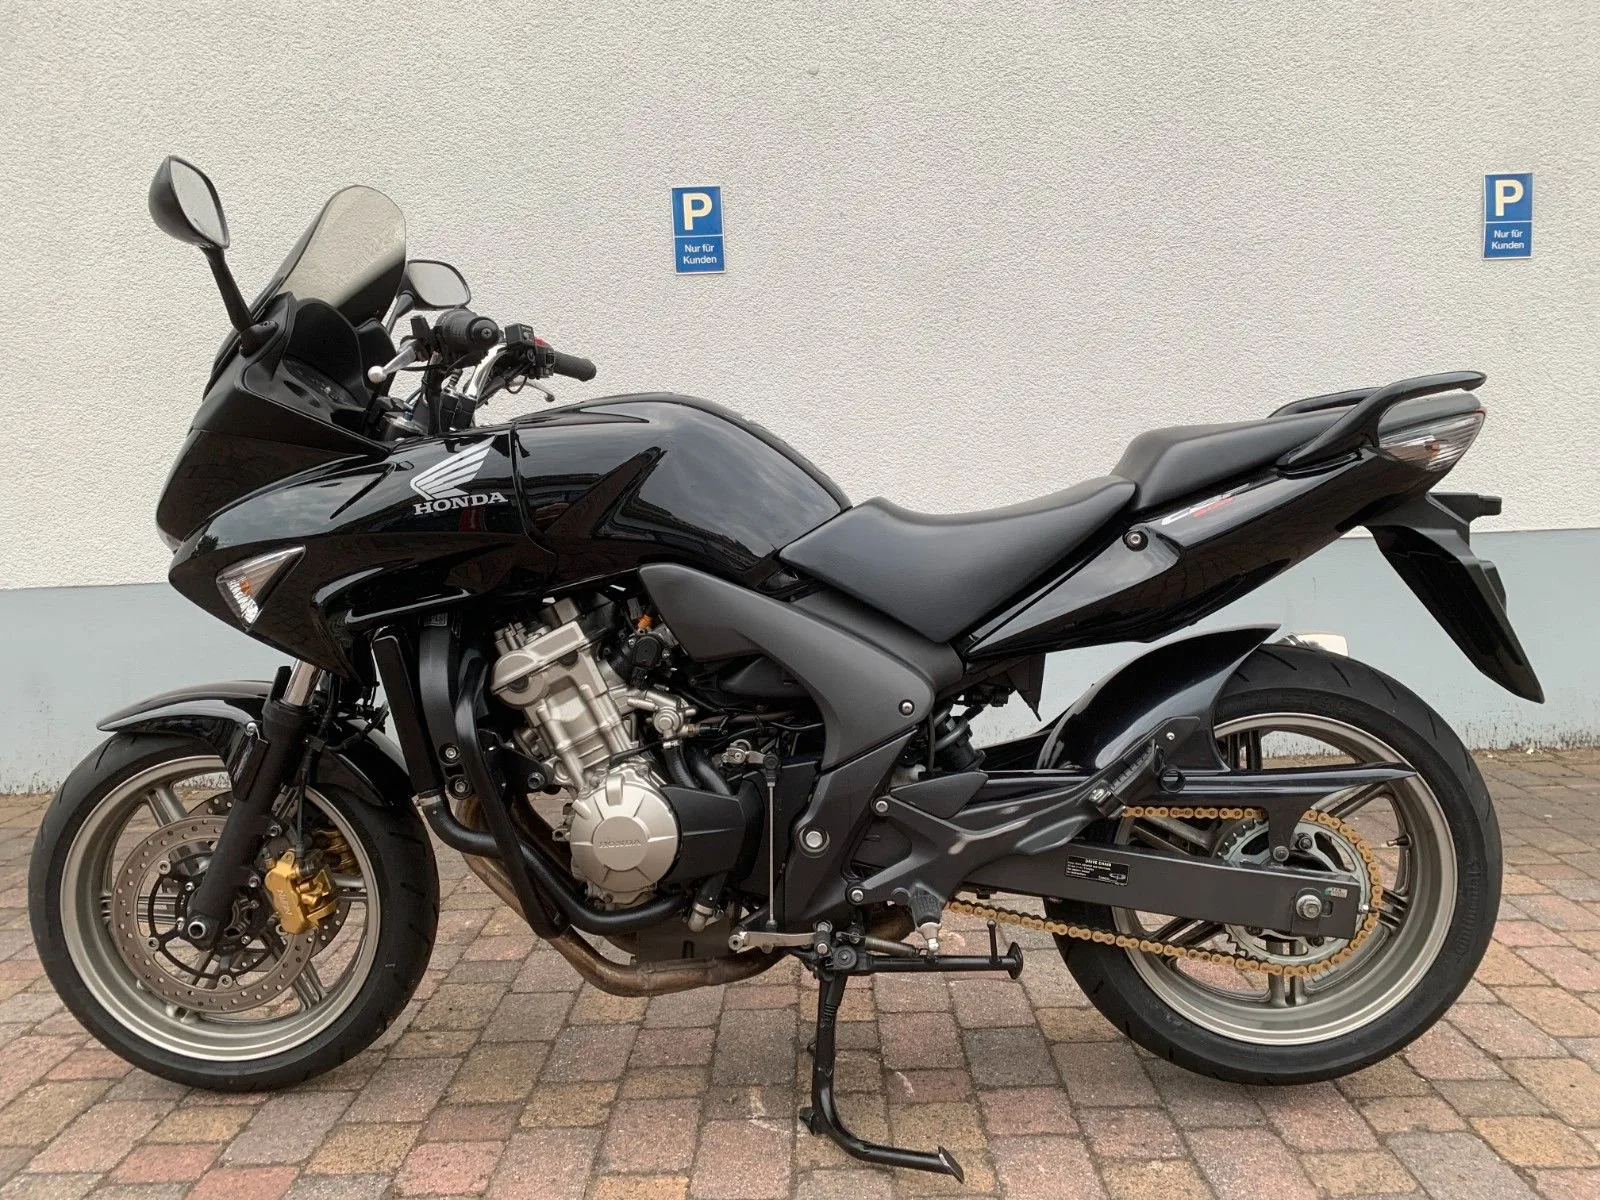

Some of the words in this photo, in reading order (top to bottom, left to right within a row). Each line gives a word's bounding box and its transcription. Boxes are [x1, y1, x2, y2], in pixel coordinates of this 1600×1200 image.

[1495, 180, 1524, 217] P
[682, 193, 713, 231] P
[1494, 230, 1509, 238] Nur
[1511, 229, 1523, 238] für
[684, 244, 701, 253] Nur
[702, 243, 715, 252] für
[1491, 241, 1525, 250] Kunden
[683, 256, 717, 265] Kunden
[413, 492, 509, 515] HONDA
[599, 839, 642, 849] HONDA
